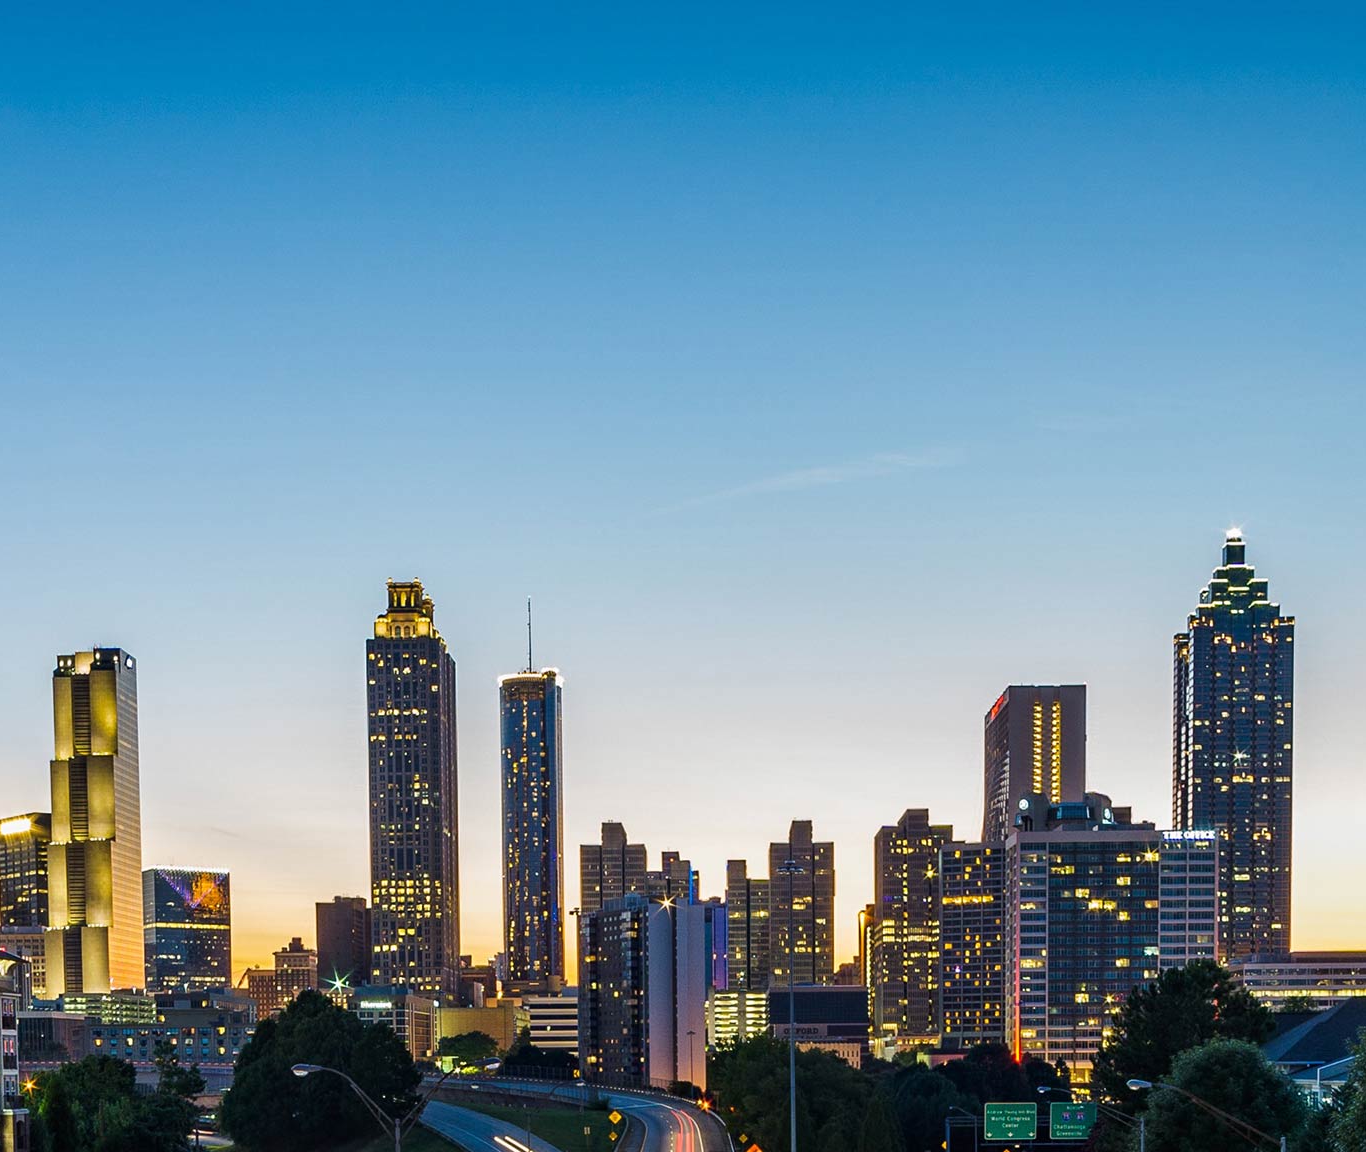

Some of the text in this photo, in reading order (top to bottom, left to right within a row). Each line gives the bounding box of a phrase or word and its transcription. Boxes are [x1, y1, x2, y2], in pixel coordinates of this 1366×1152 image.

[1162, 831, 1215, 839] THE OFFICE
[783, 1027, 819, 1035] OFORD
